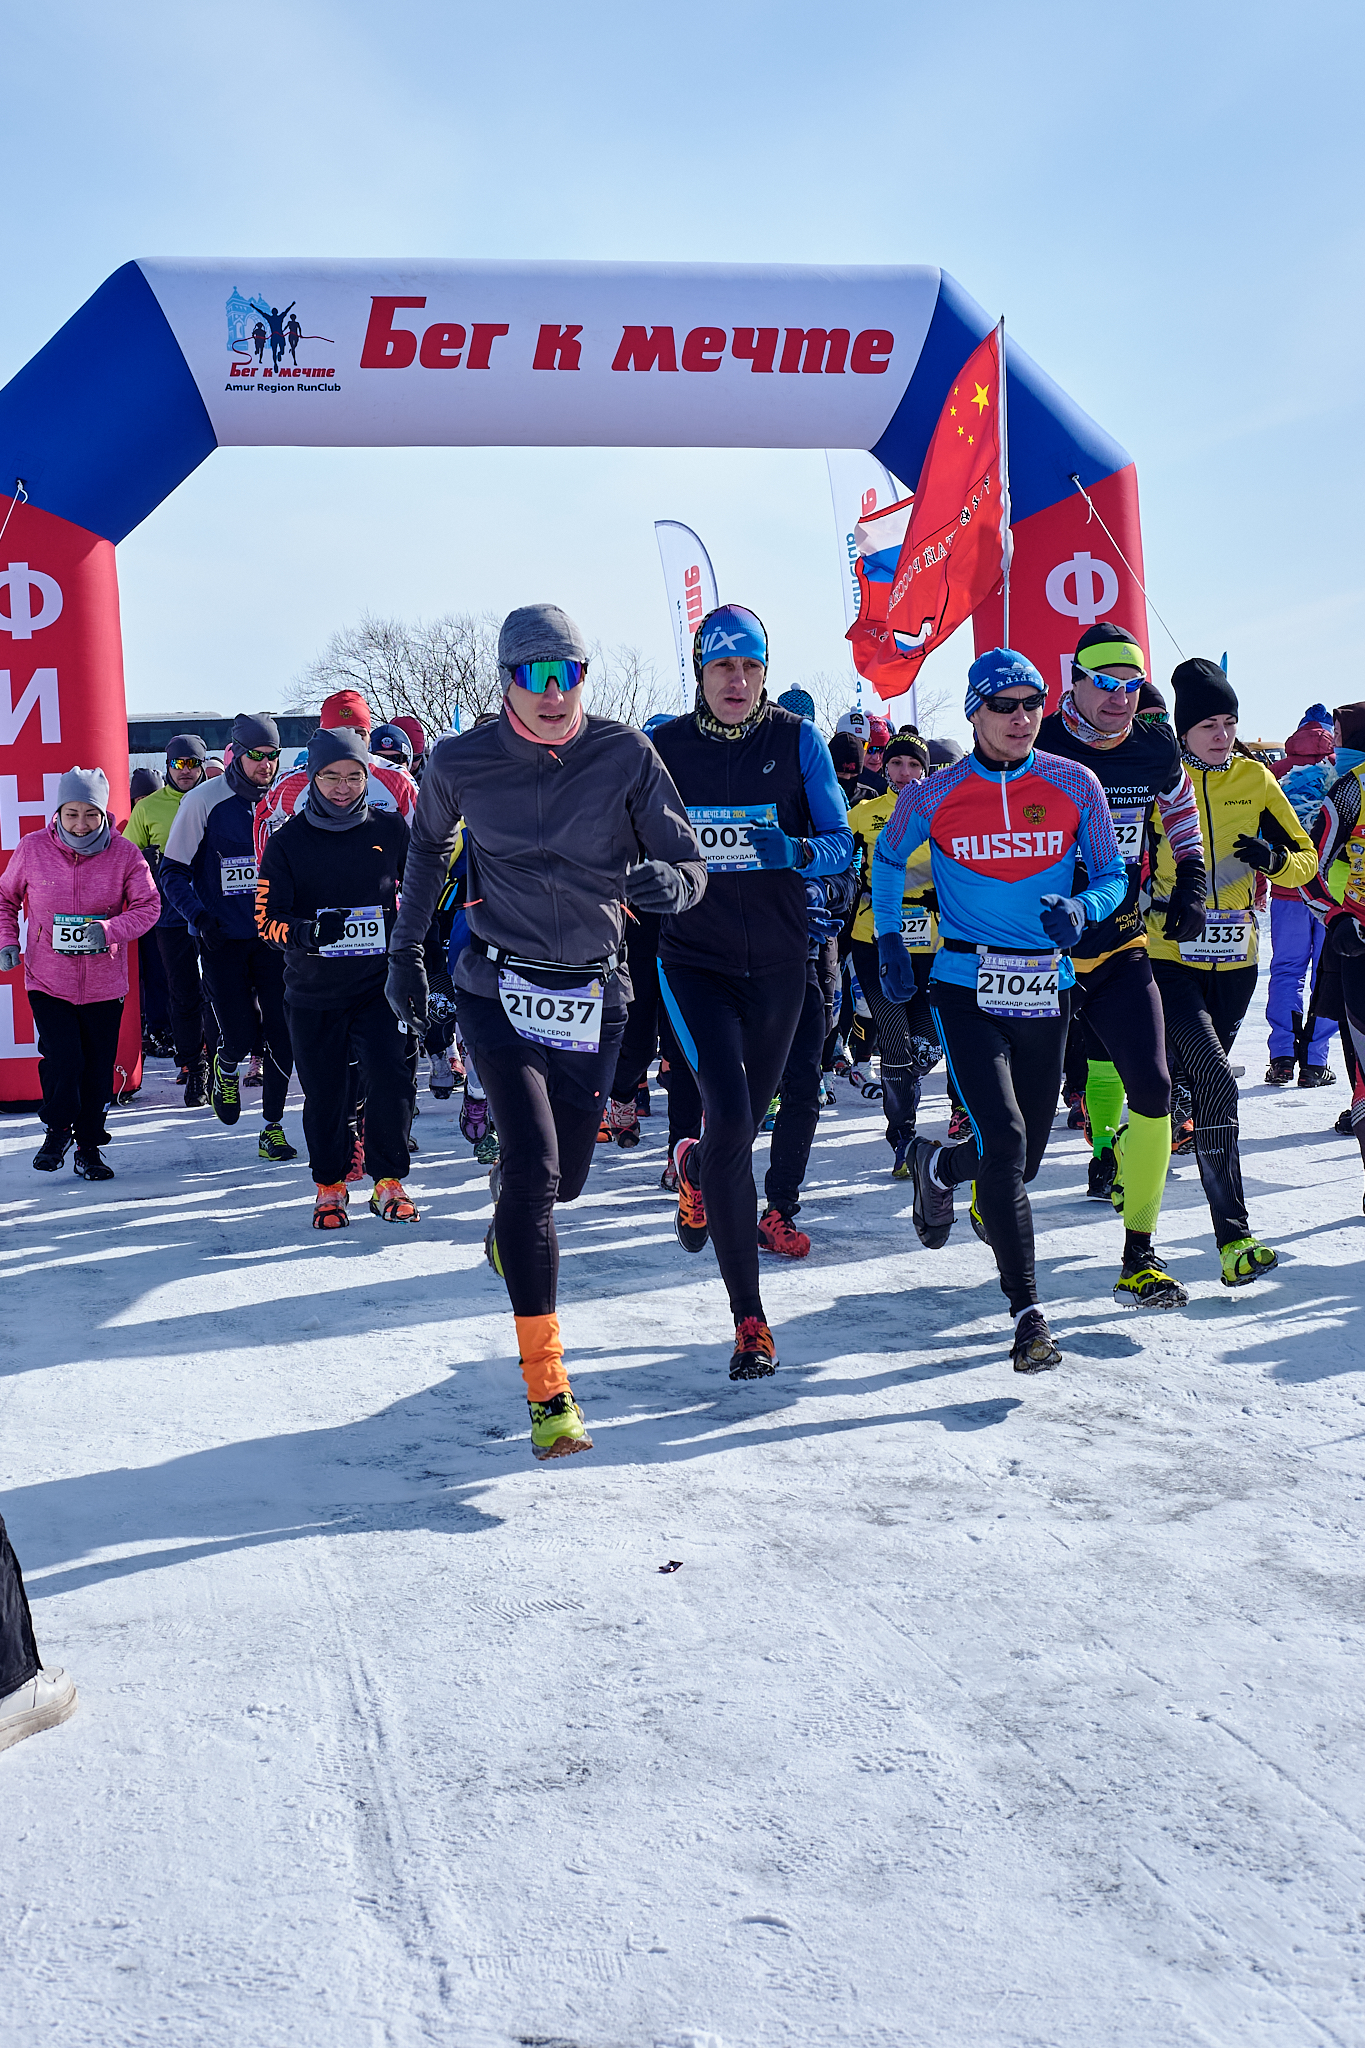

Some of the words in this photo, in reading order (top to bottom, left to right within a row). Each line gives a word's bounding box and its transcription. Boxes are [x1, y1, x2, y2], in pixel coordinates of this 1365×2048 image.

[360, 296, 509, 370] Бег
[532, 324, 583, 371] к
[611, 325, 895, 374] мечте
[230, 362, 258, 377] Бег
[263, 367, 273, 378] к
[278, 367, 335, 378] мечте
[224, 383, 255, 392] Amur
[257, 382, 295, 394] Region
[297, 382, 342, 392] RunClub
[996, 674, 1040, 688] adidas
[1103, 785, 1150, 794] DIVOSTOK
[1111, 794, 1156, 805] TRIATHLON
[732, 810, 746, 819] 2024
[951, 830, 1064, 861] RUSSIA
[226, 867, 258, 882] 210
[60, 927, 90, 942] 50
[345, 921, 379, 939] 019
[1195, 926, 1246, 944] 1333
[978, 972, 1058, 996] 21044
[505, 993, 596, 1025] 21037
[985, 999, 1023, 1007] АЛЕКСАНДР
[547, 1029, 571, 1037] СЕРОВ
